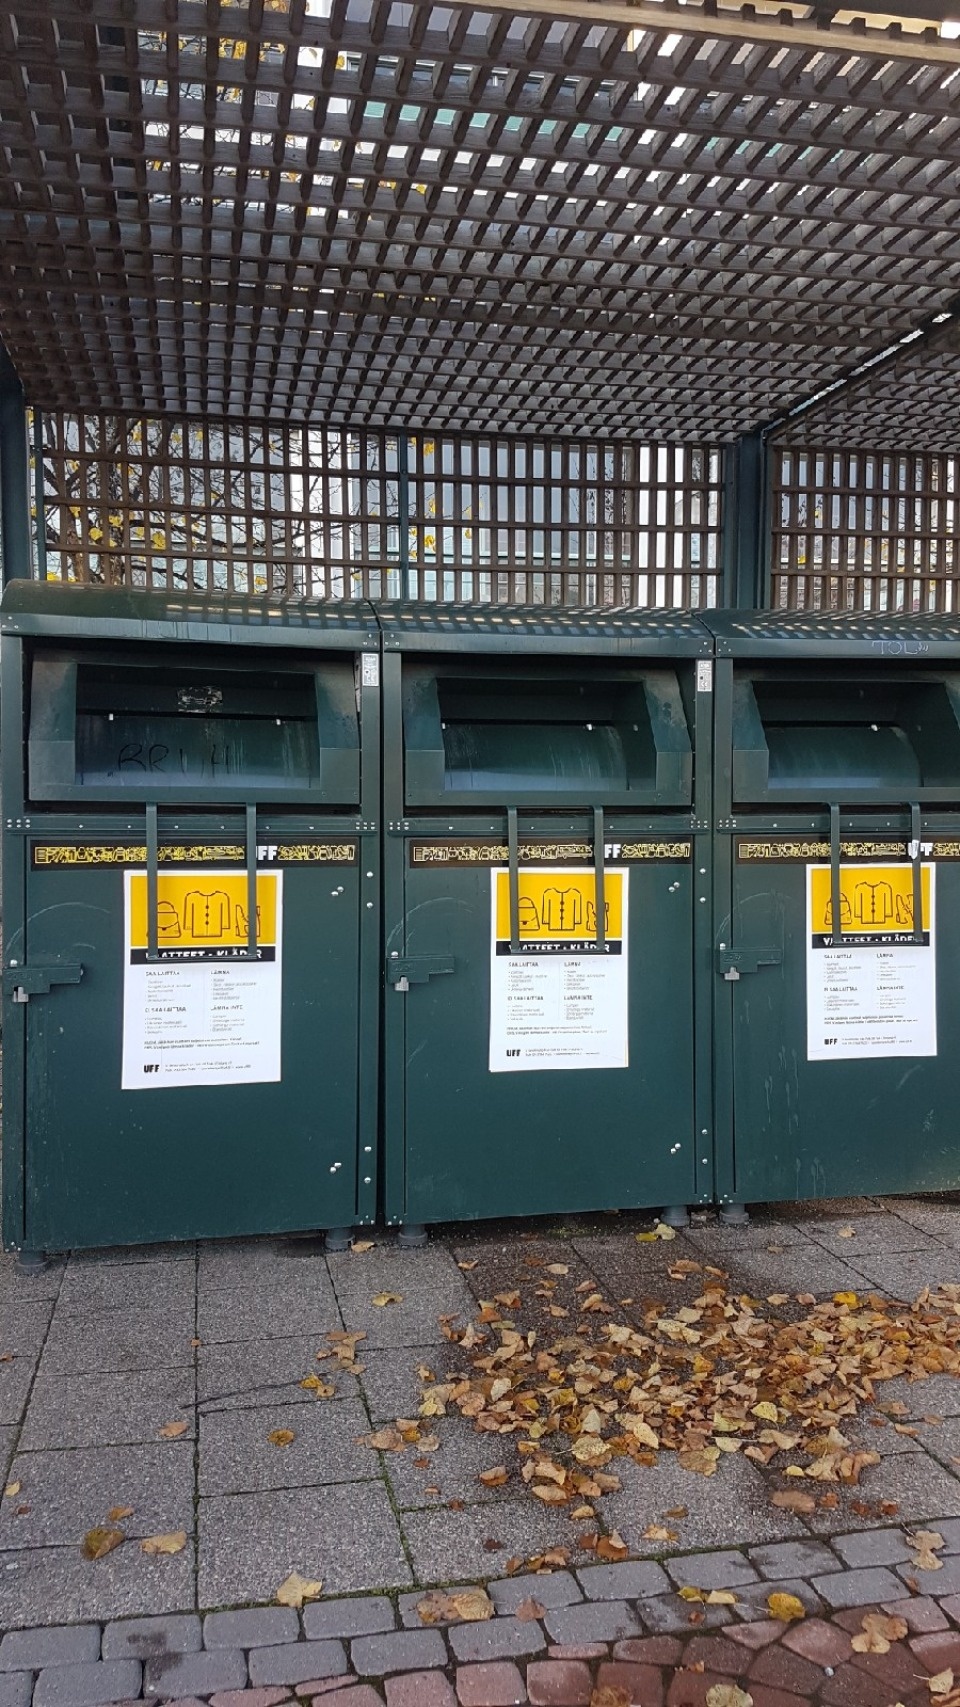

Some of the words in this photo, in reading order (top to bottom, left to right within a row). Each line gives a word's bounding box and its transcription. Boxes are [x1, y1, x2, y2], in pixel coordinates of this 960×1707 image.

[255, 845, 278, 861] FF
[603, 843, 621, 859] FF
[506, 1049, 521, 1058] UFF
[143, 1063, 160, 1073] UFF
